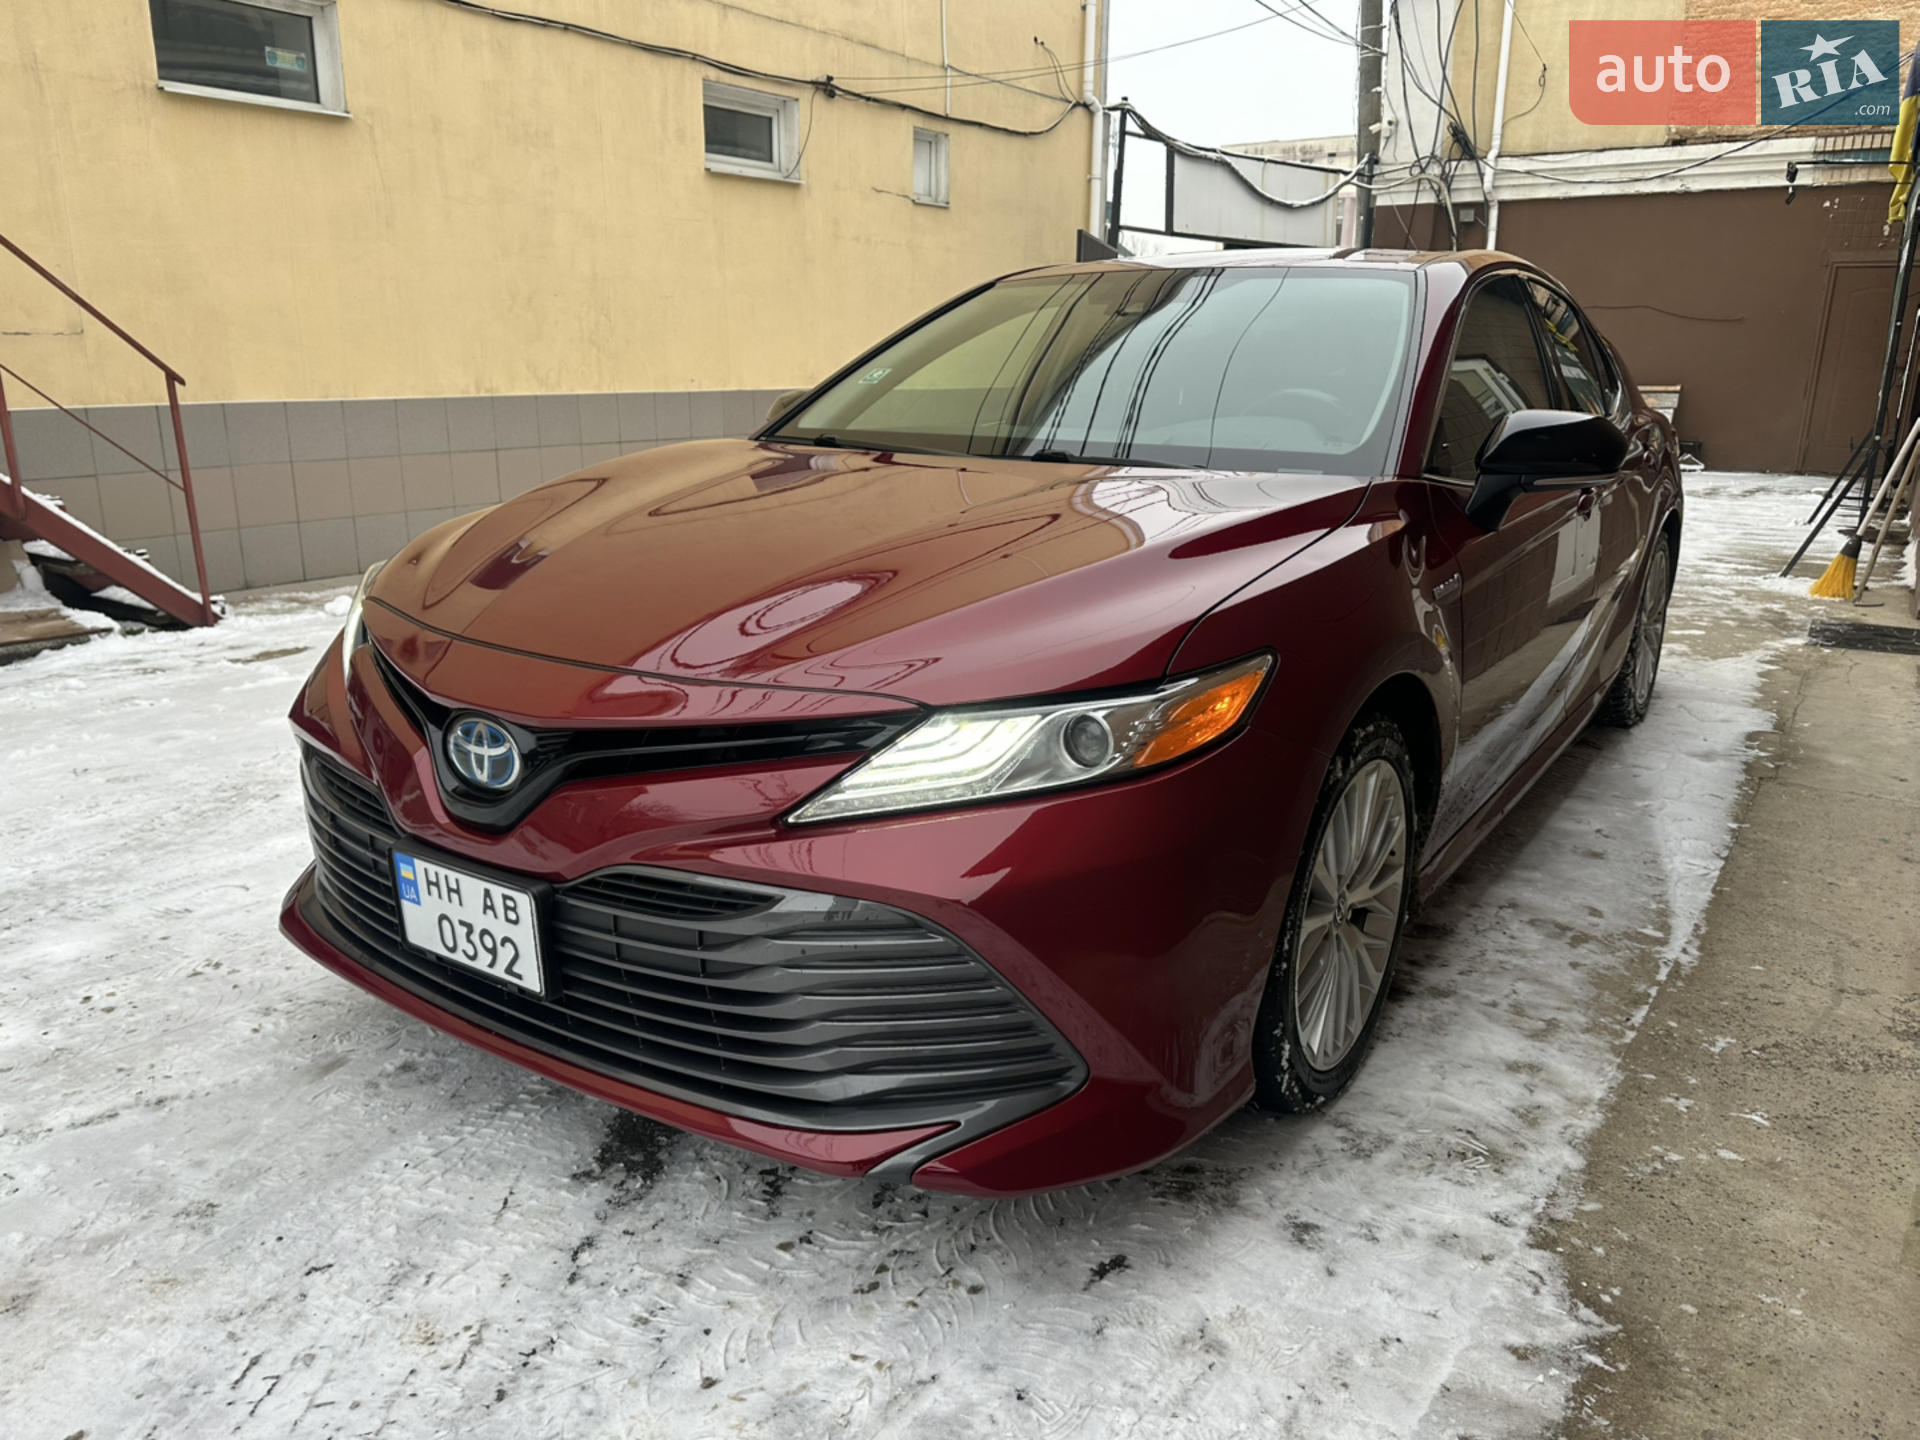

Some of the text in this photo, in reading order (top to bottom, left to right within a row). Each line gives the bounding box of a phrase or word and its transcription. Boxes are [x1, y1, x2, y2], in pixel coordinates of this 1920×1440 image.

[401, 883, 417, 901] UA
[424, 867, 520, 926] HH AB
[438, 913, 523, 981] 0392
